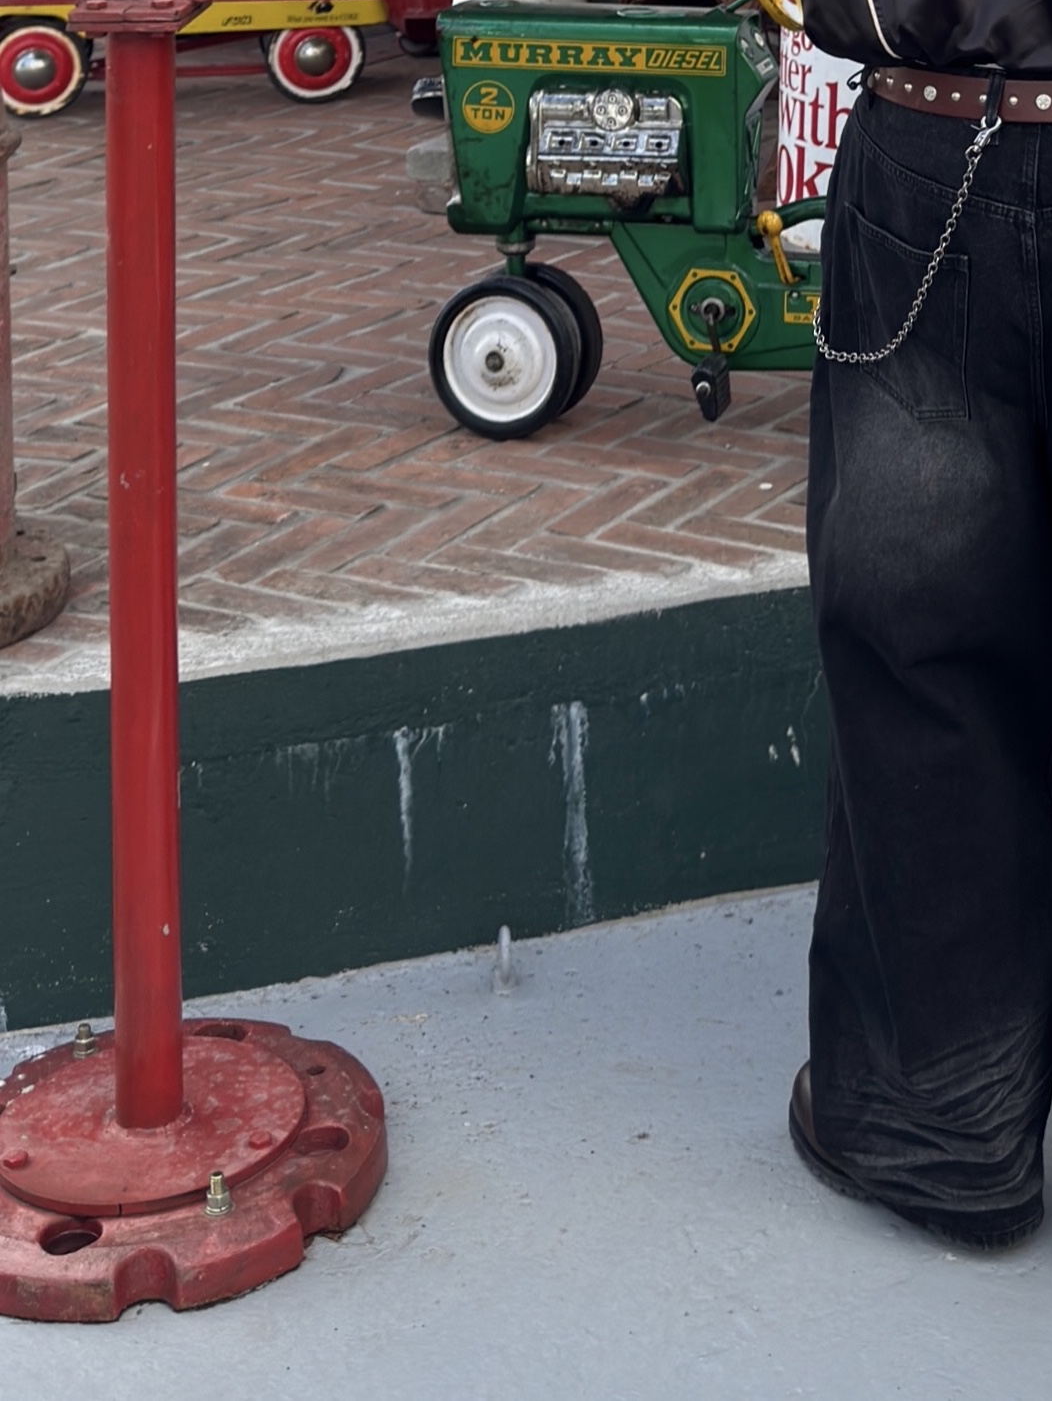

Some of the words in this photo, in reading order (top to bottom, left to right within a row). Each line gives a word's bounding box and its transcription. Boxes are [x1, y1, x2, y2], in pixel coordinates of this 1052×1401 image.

[460, 41, 643, 67] MURRAY
[648, 49, 723, 70] DIESEL
[480, 87, 498, 106] 2
[471, 106, 505, 121] TON
[780, 82, 852, 150] with
